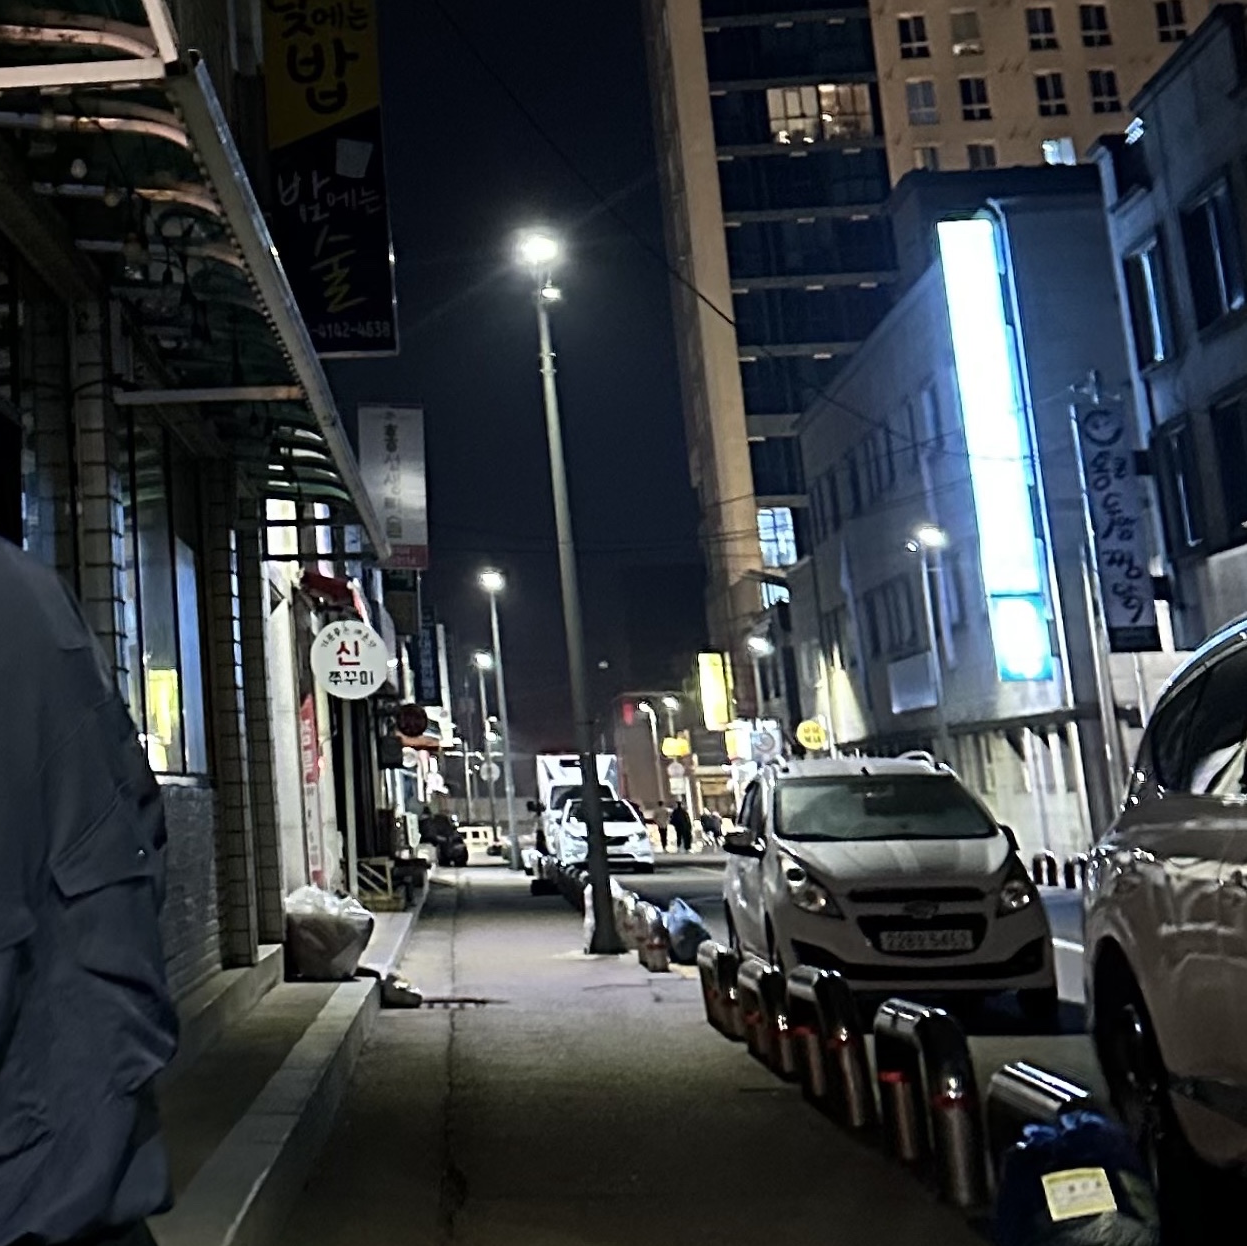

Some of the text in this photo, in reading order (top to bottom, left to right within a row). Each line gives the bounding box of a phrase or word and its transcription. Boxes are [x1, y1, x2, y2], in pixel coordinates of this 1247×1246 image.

[287, 38, 359, 114] 밥
[278, 169, 384, 224] 밤에는
[310, 224, 369, 314] 술
[336, 641, 361, 666] 신
